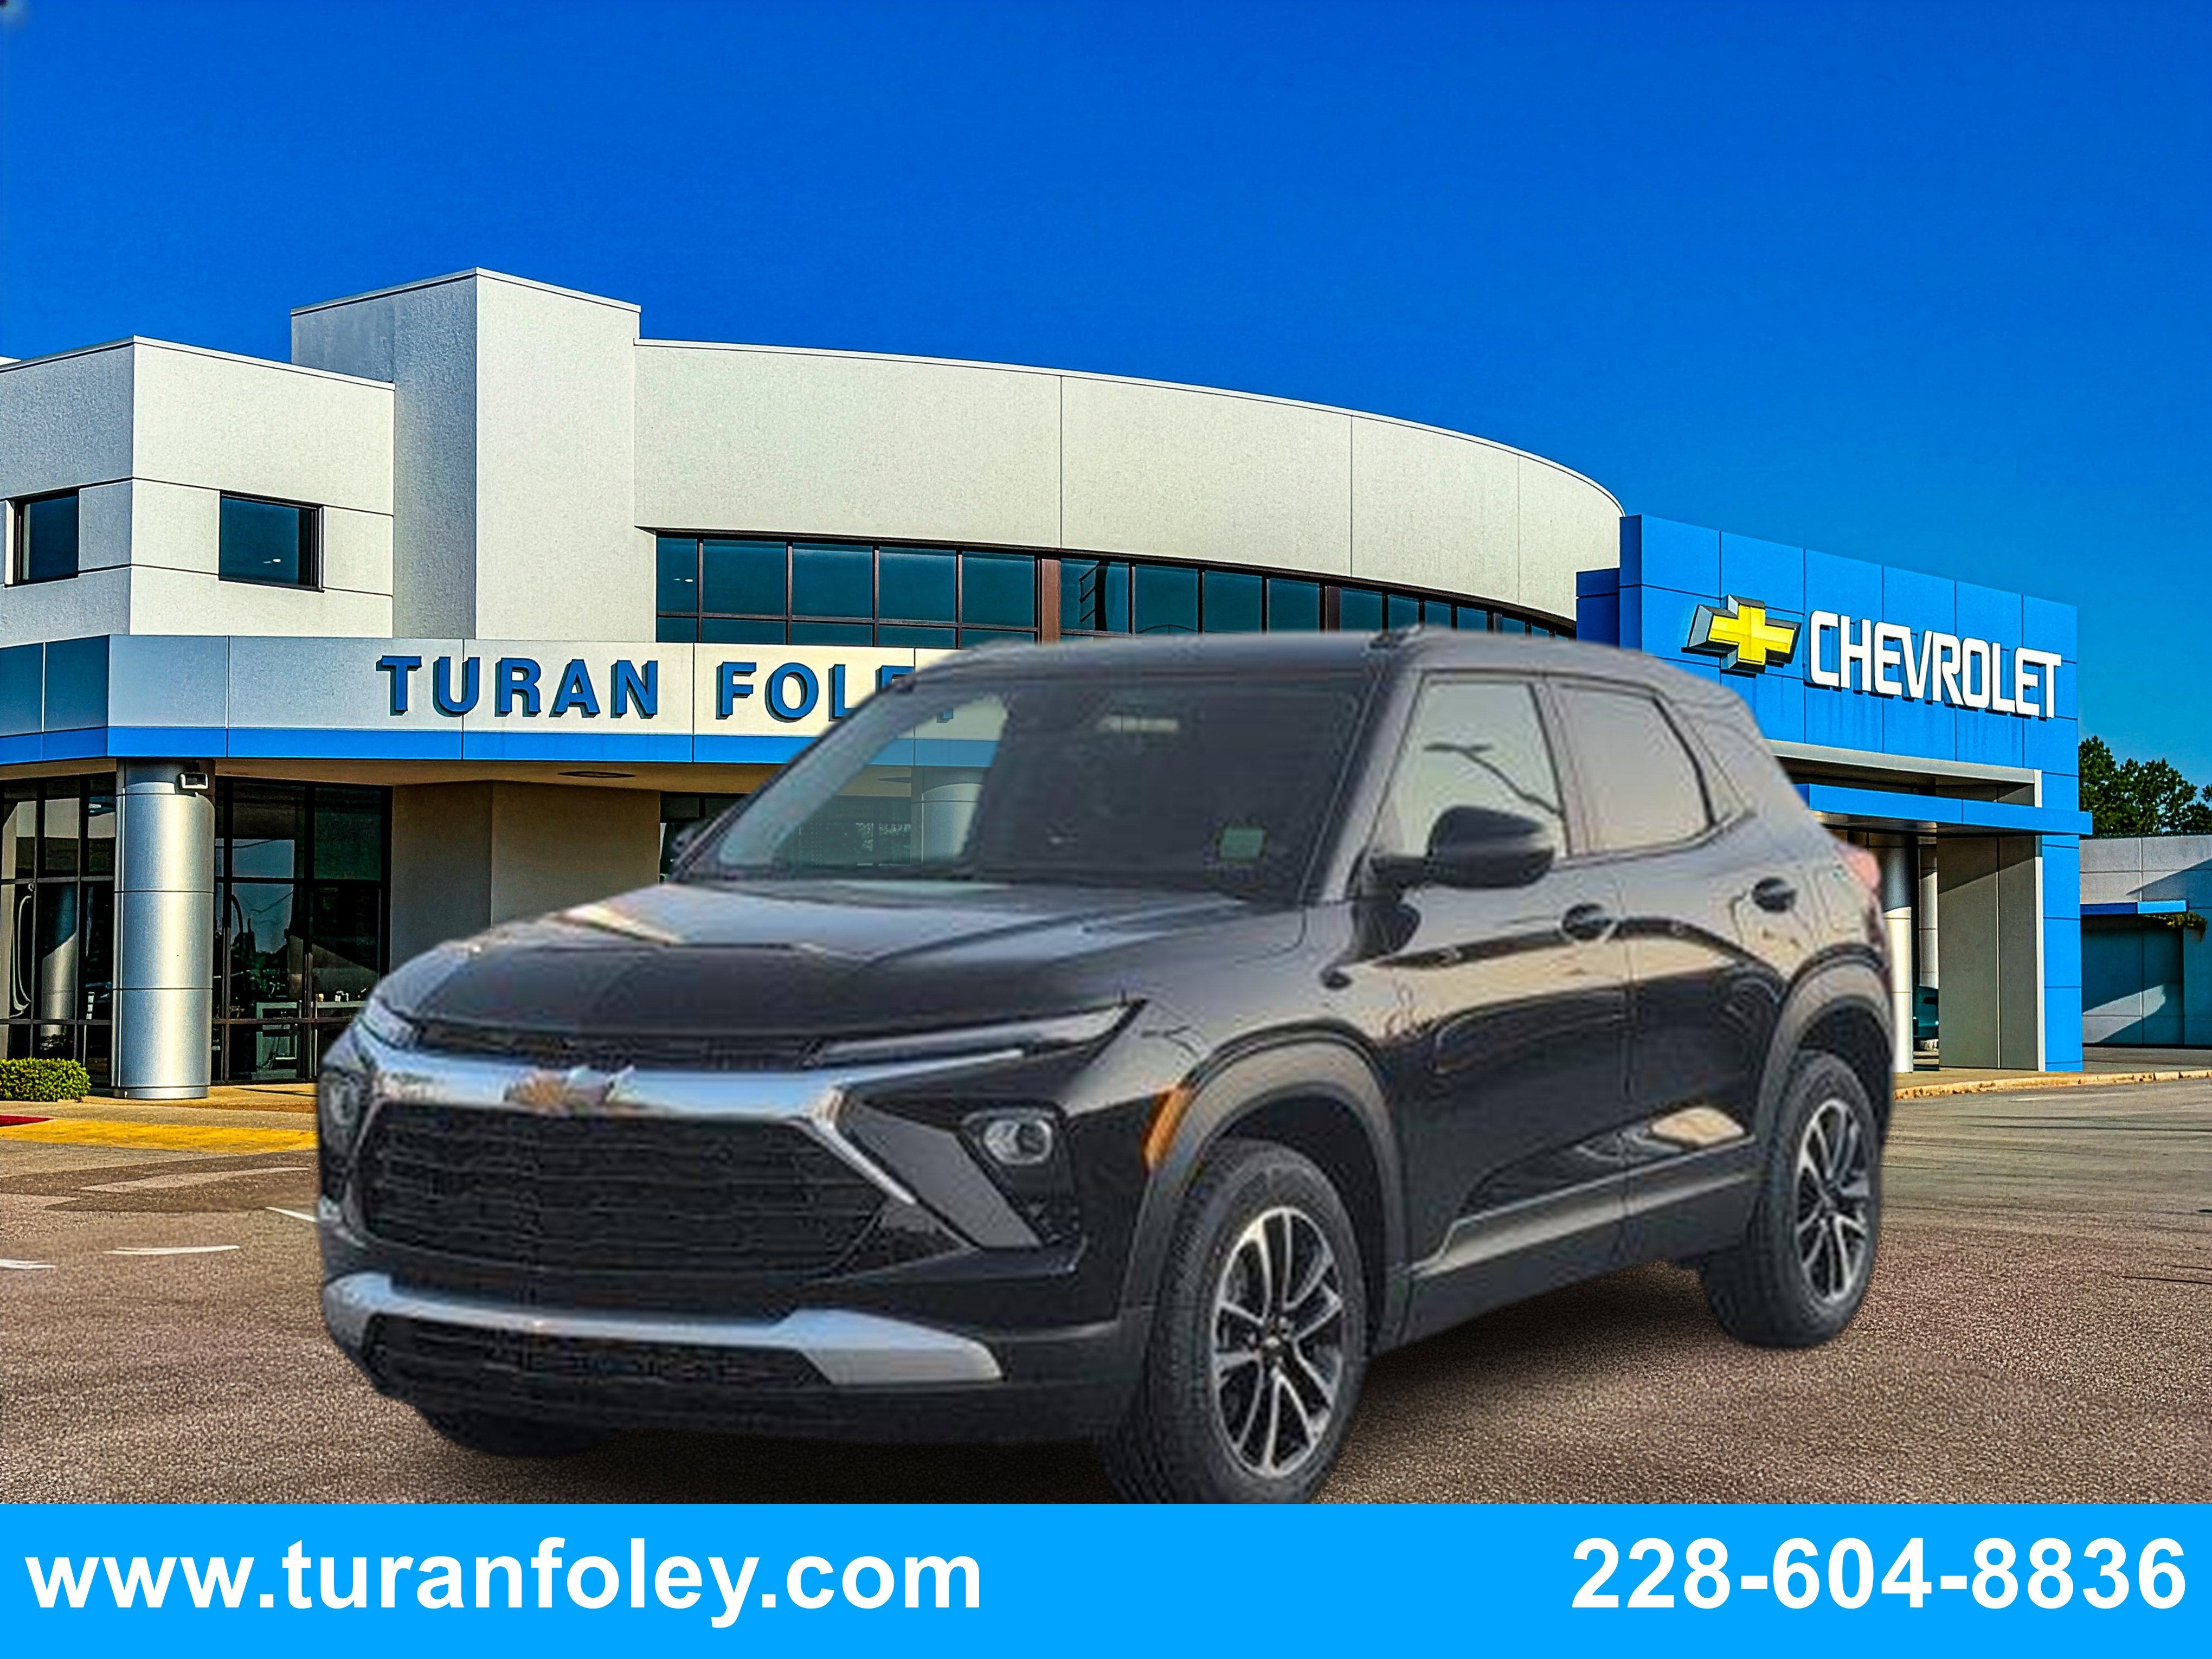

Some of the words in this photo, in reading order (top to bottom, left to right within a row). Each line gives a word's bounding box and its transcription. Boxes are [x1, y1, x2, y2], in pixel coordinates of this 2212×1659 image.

[376, 655, 659, 719] TURAN
[716, 661, 954, 723] FOL
[1810, 610, 2062, 718] CHEVROLET
